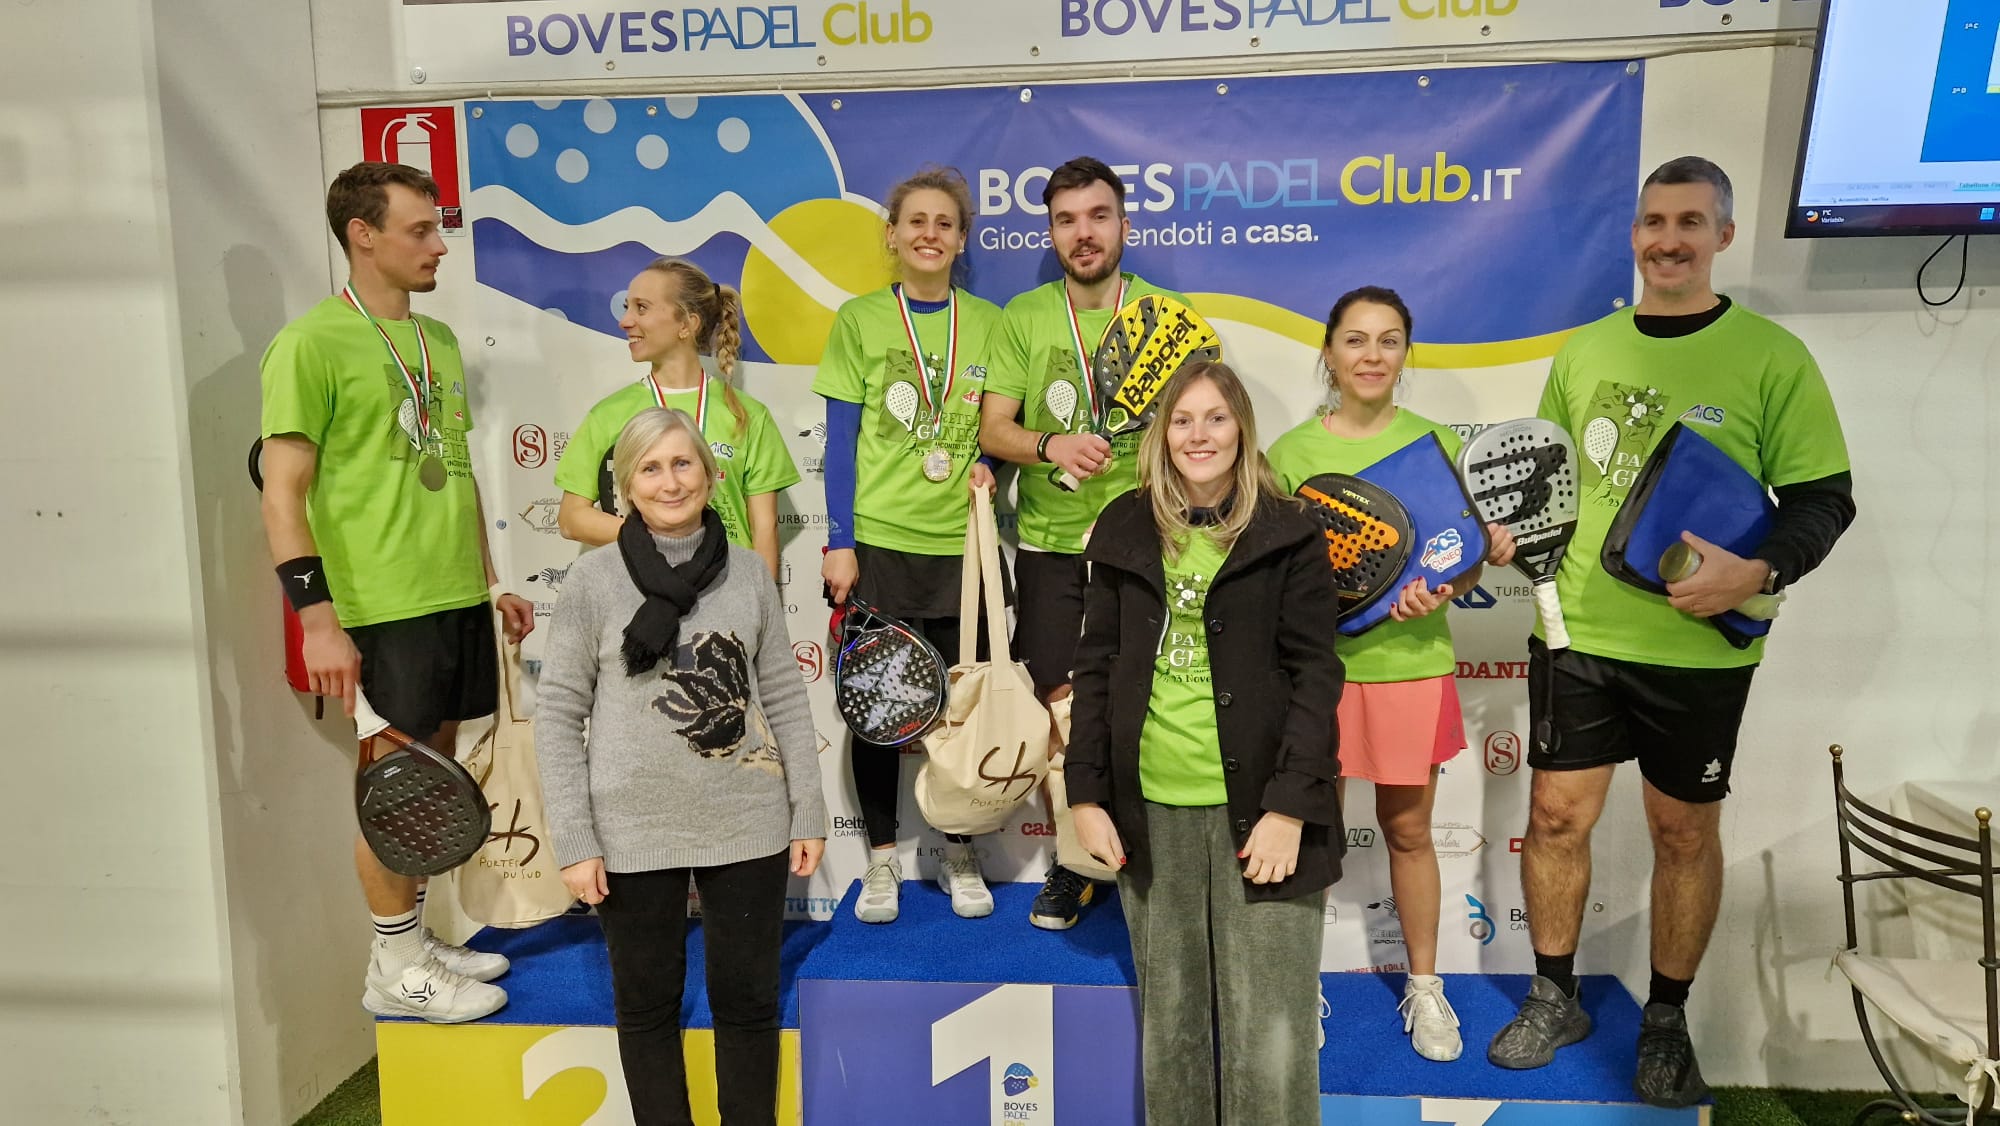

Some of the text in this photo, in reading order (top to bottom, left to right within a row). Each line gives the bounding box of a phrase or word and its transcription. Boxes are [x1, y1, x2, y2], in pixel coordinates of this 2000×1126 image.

[507, 0, 933, 57] BOVES PADEL Club
[979, 163, 1174, 216] BOES
[1184, 158, 1338, 212] PADEL
[1126, 221, 1213, 247] endoti
[1222, 228, 1238, 244] a
[1245, 221, 1320, 244] casa.
[777, 514, 810, 524] URBO
[1431, 548, 1461, 569] CUNEO
[1003, 1102, 1038, 1111] BOVES
